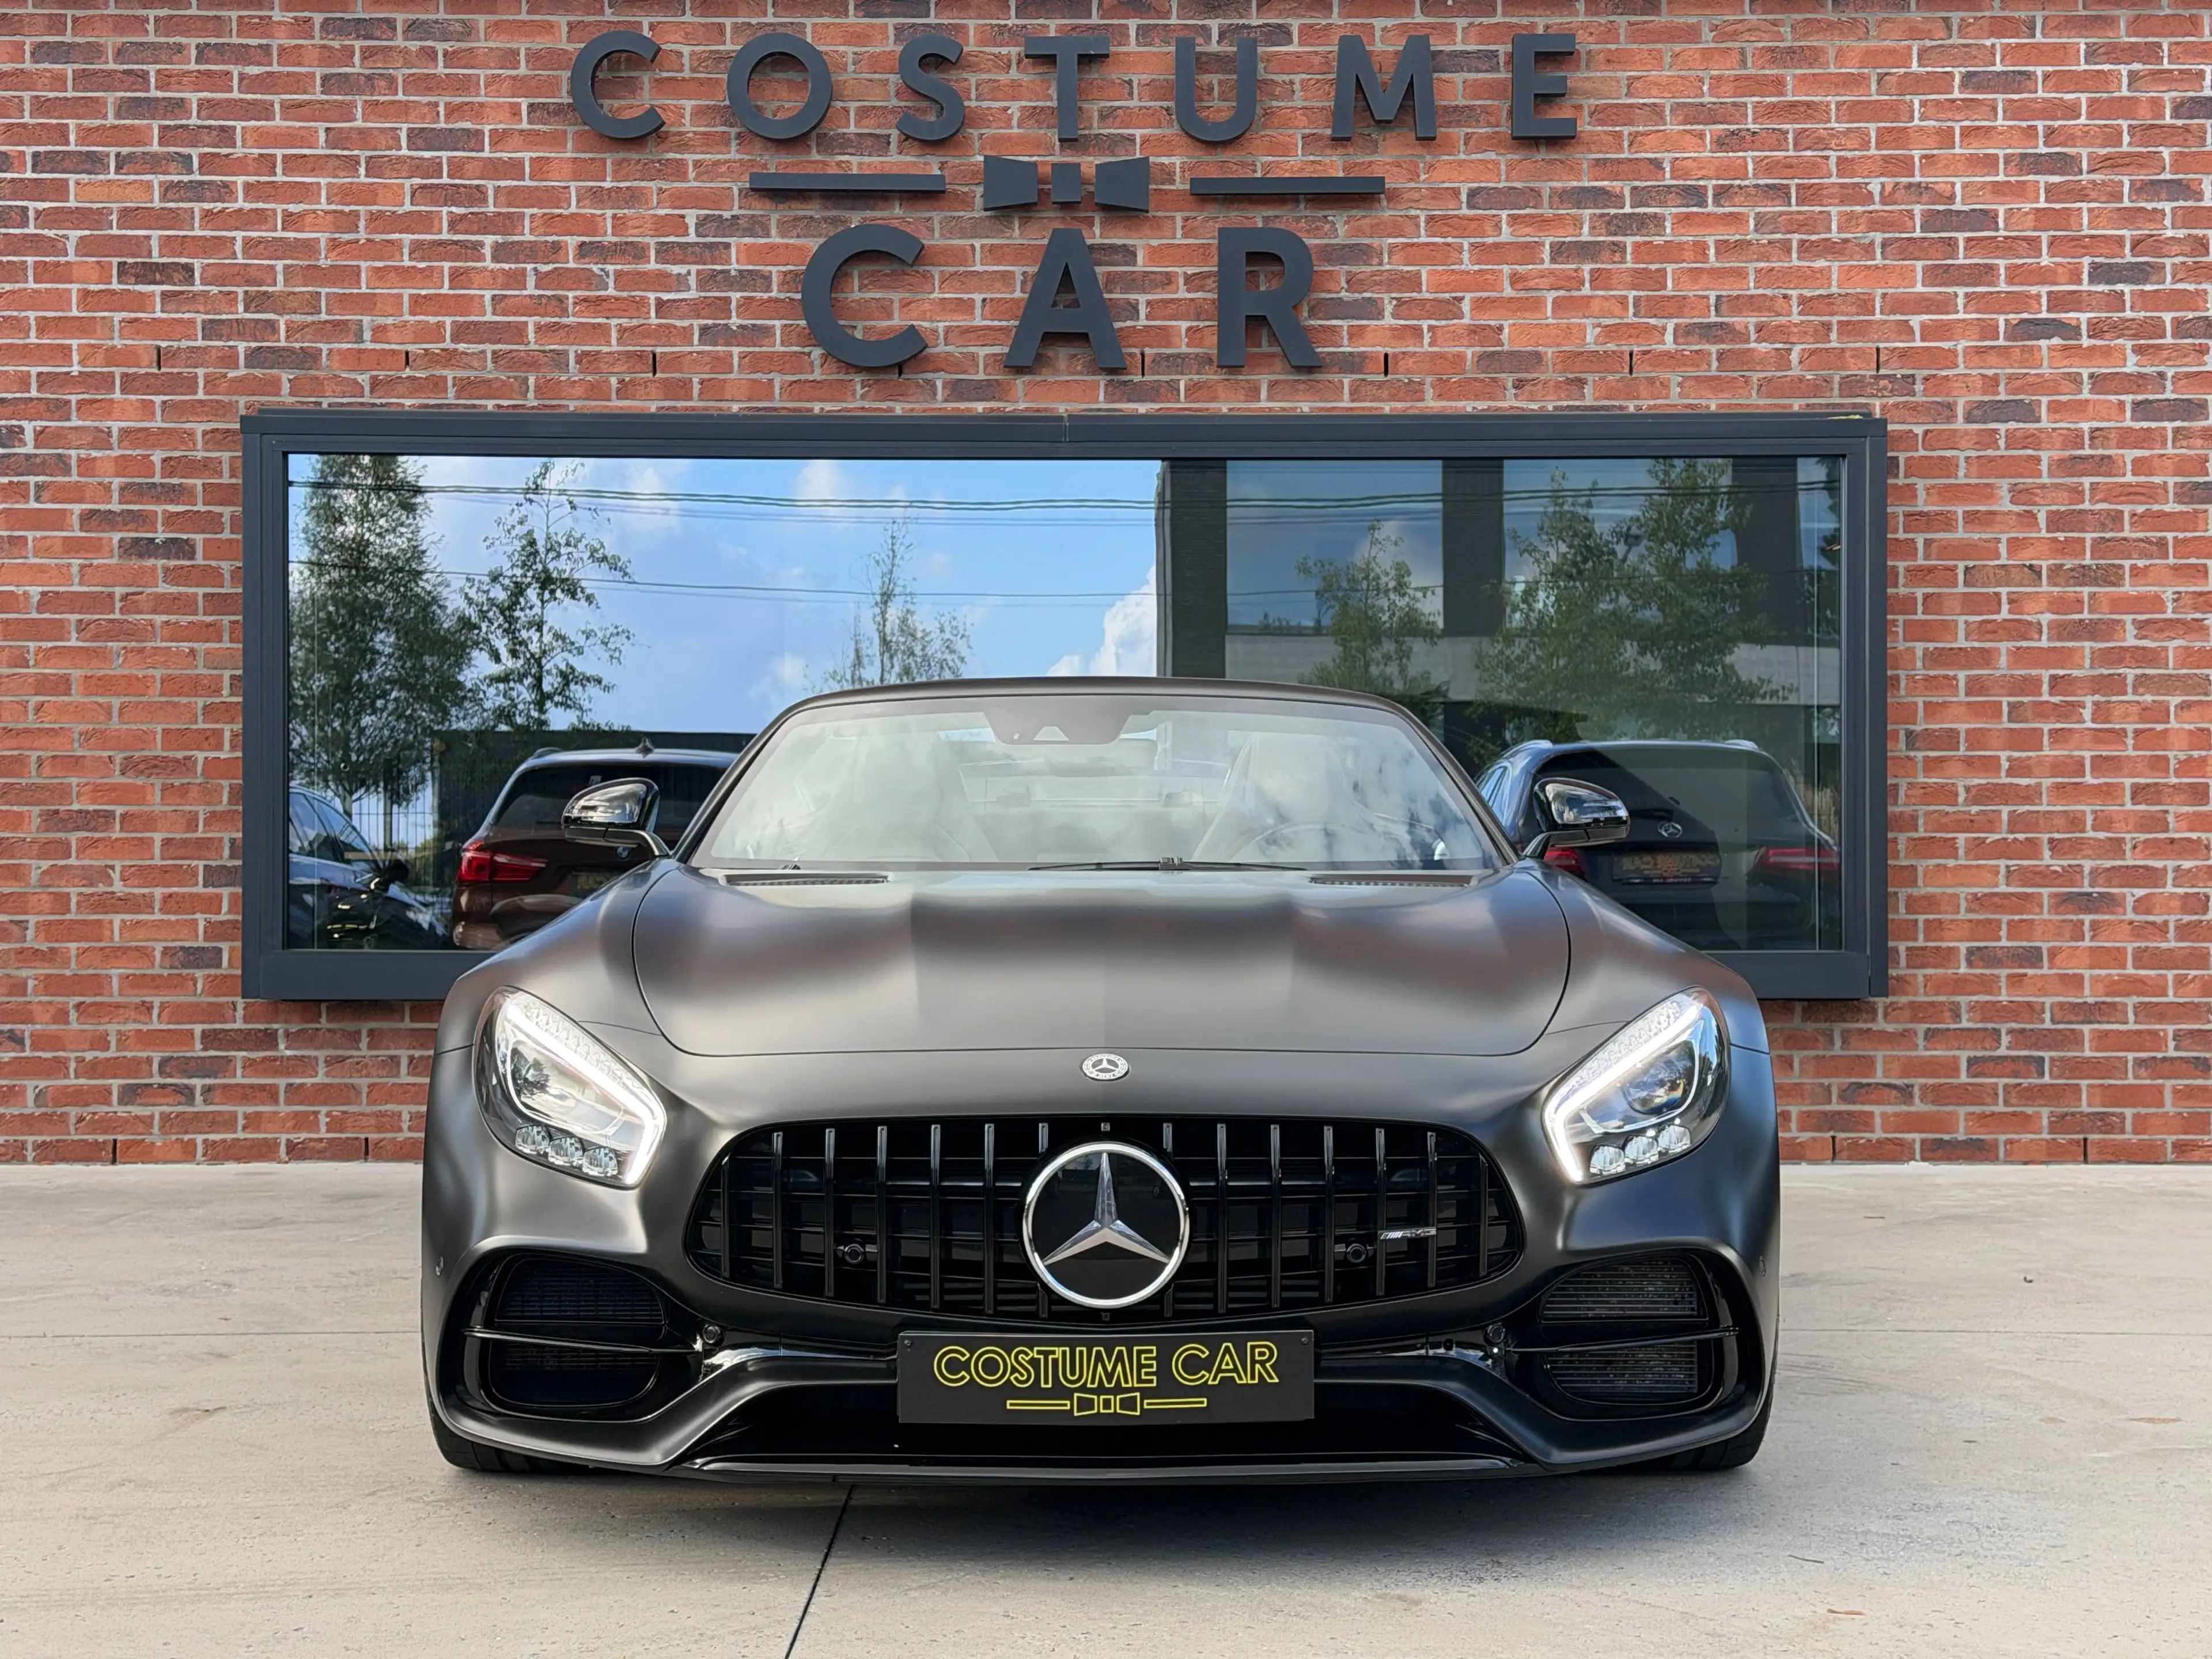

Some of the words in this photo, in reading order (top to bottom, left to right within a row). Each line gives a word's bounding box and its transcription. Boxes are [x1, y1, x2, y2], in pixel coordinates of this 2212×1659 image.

[574, 31, 1578, 142] COSTUME
[802, 224, 1323, 370] CAR
[1399, 1228, 1437, 1238] AMG
[933, 1346, 1157, 1388] COSTUME
[1172, 1340, 1279, 1384] CAR
